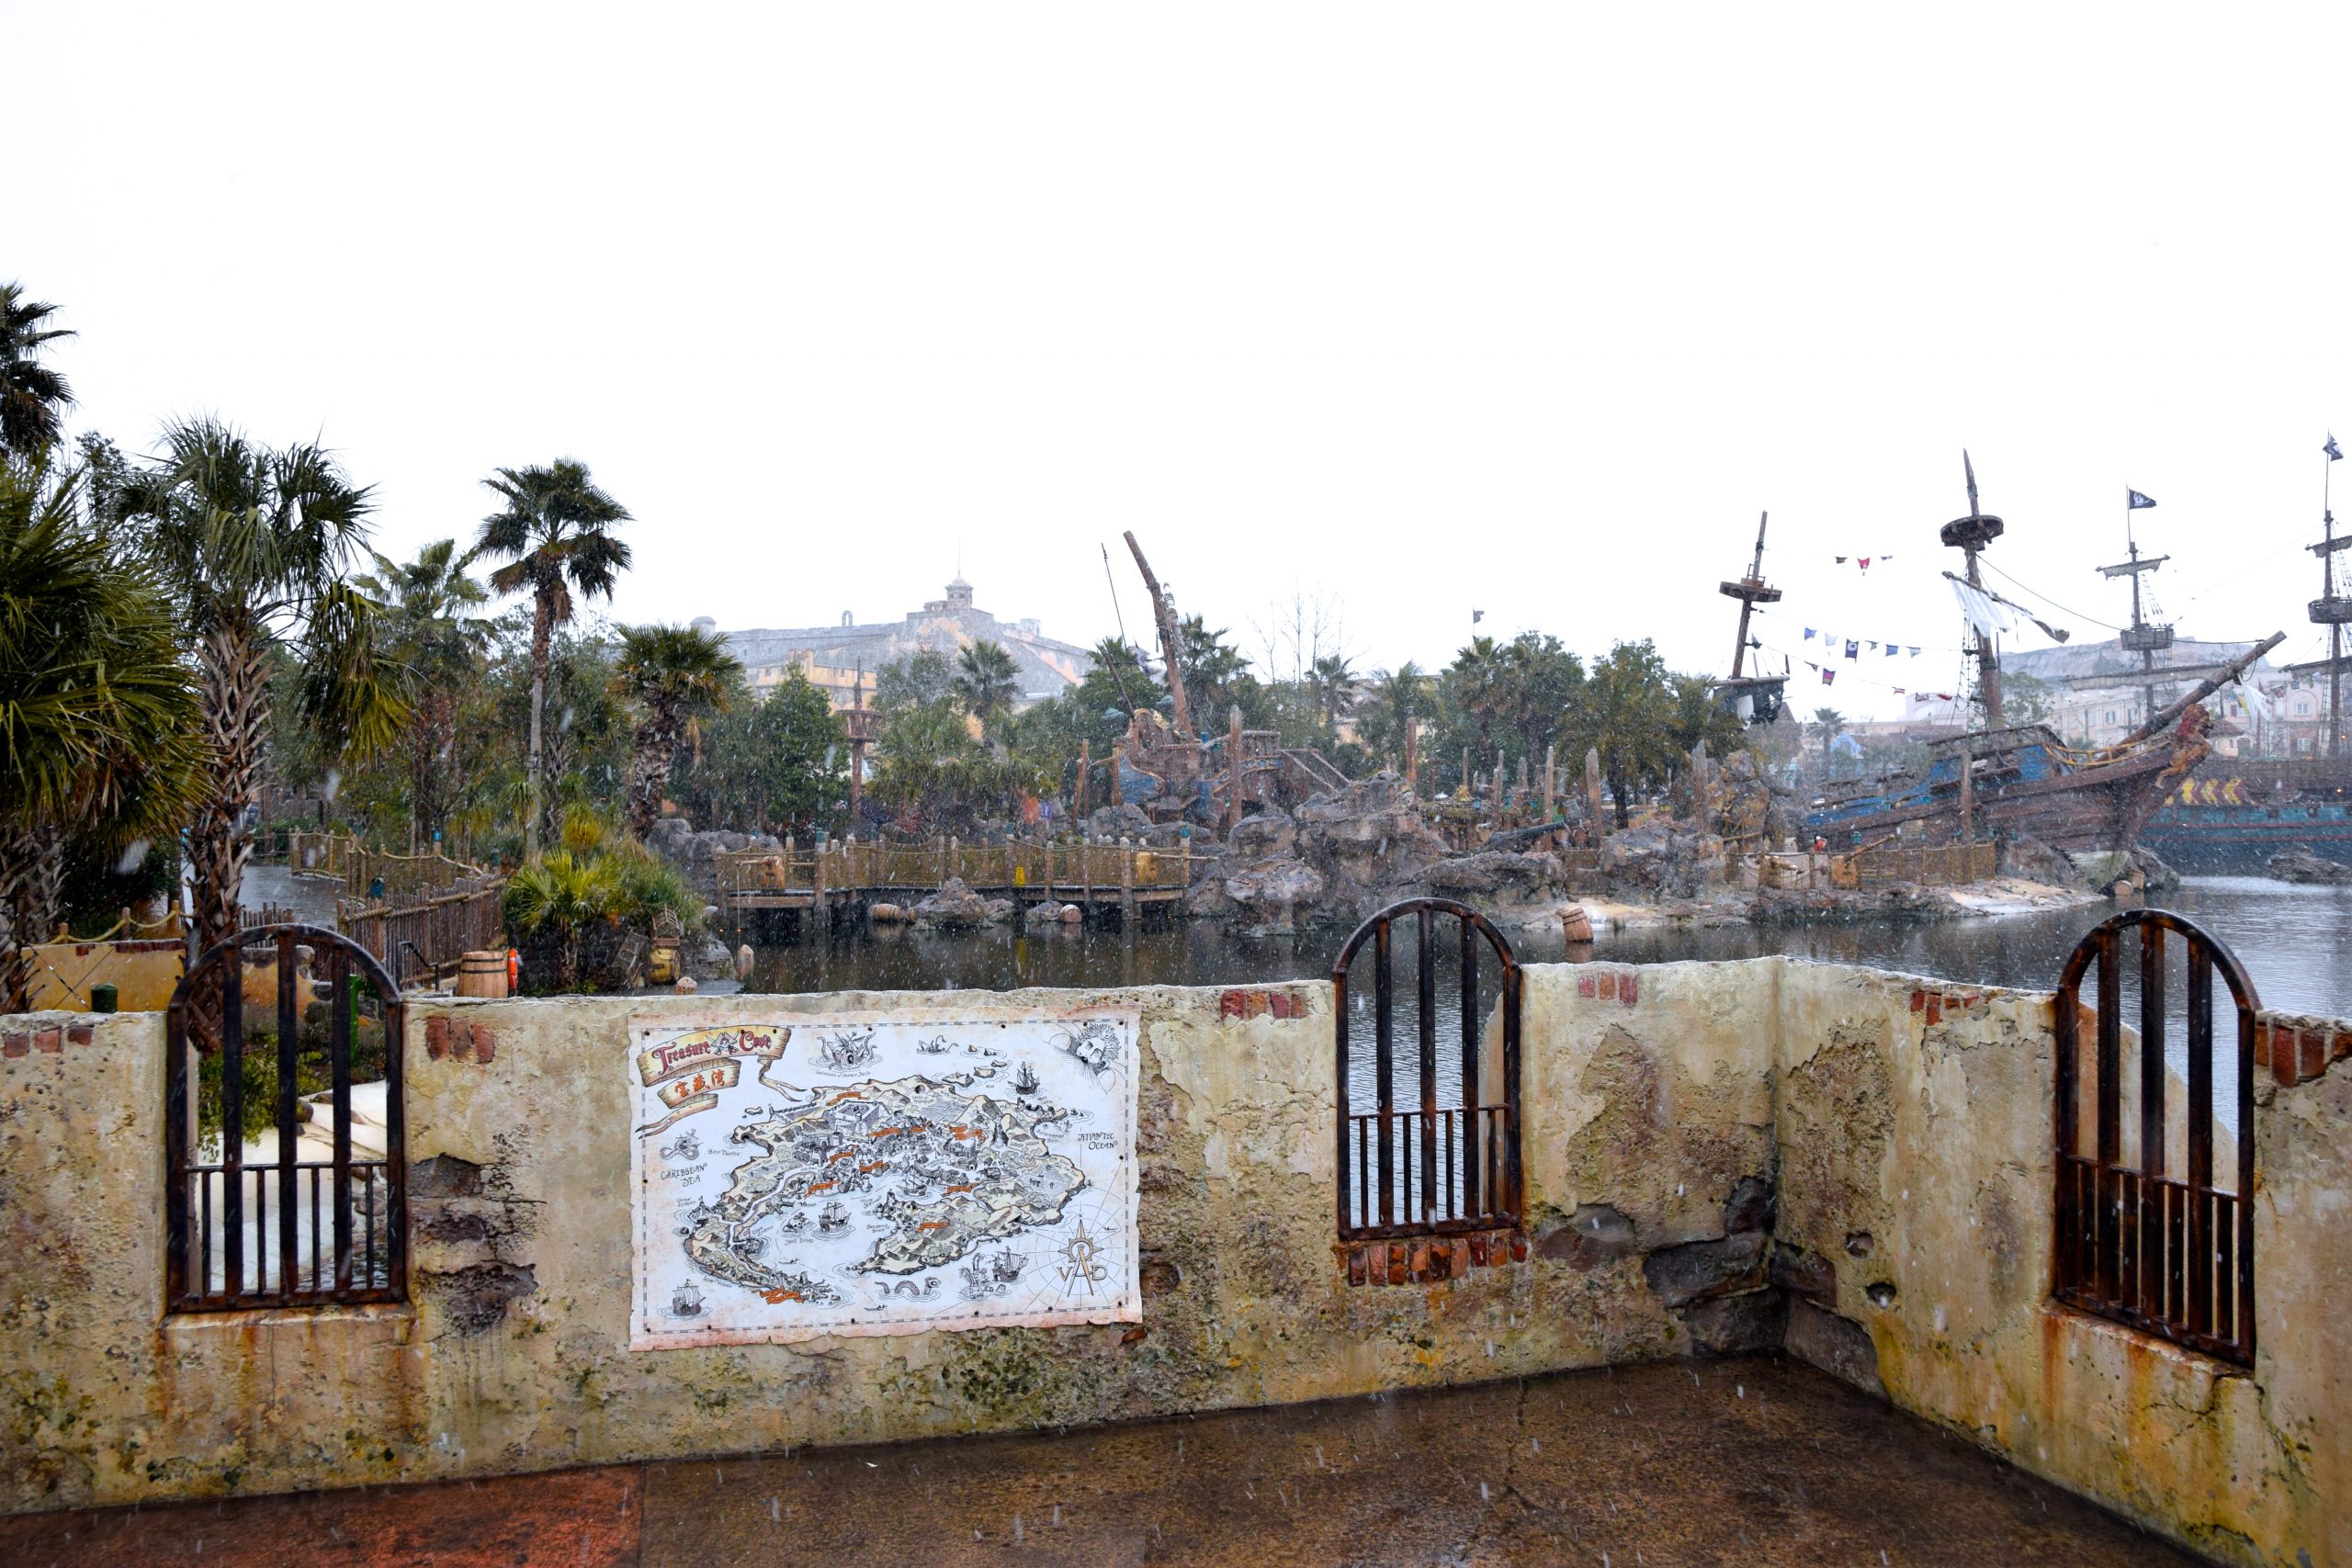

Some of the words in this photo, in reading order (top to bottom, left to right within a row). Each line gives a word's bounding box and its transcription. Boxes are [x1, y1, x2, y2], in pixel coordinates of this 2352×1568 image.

[651, 1041, 711, 1075] Treasure
[739, 1030, 773, 1052] Cove
[1088, 1141, 1118, 1150] OCEAN
[681, 1174, 701, 1188] SEA
